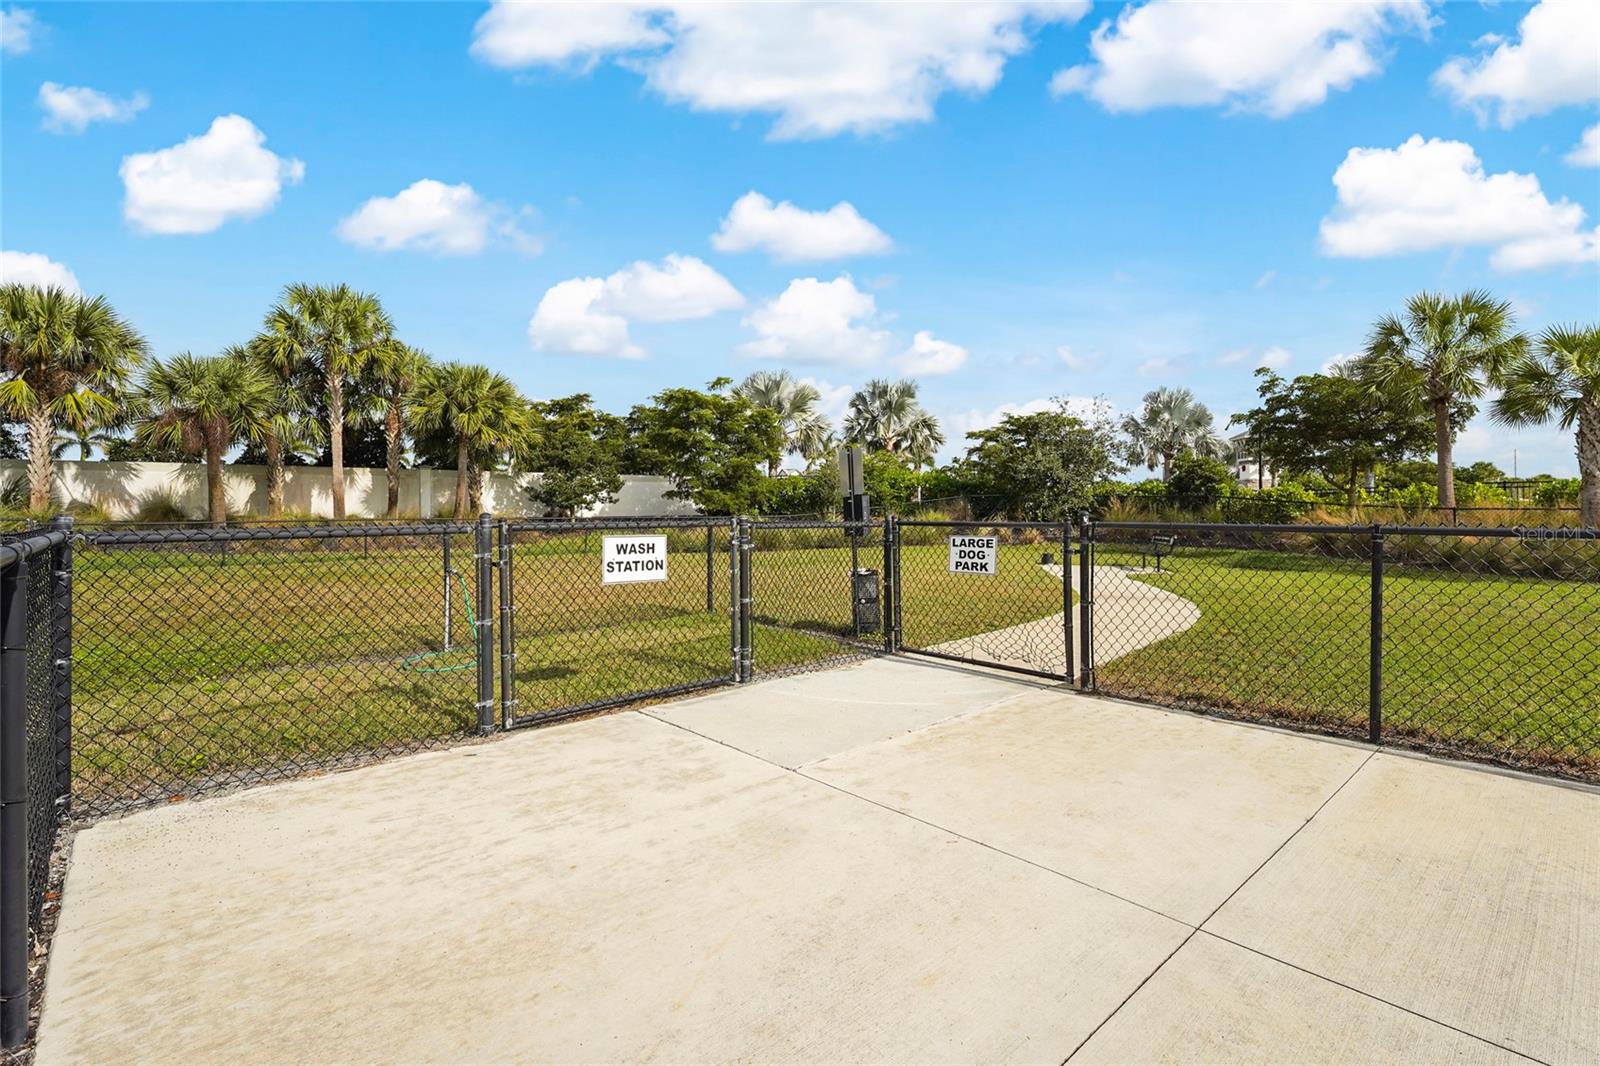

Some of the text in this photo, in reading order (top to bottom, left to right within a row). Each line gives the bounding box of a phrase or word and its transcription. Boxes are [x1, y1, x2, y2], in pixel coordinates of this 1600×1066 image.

[952, 538, 994, 548] LARGE
[616, 543, 655, 555] WASH
[959, 550, 986, 560] DOG
[606, 559, 664, 573] STATION
[955, 561, 989, 572] PARK
